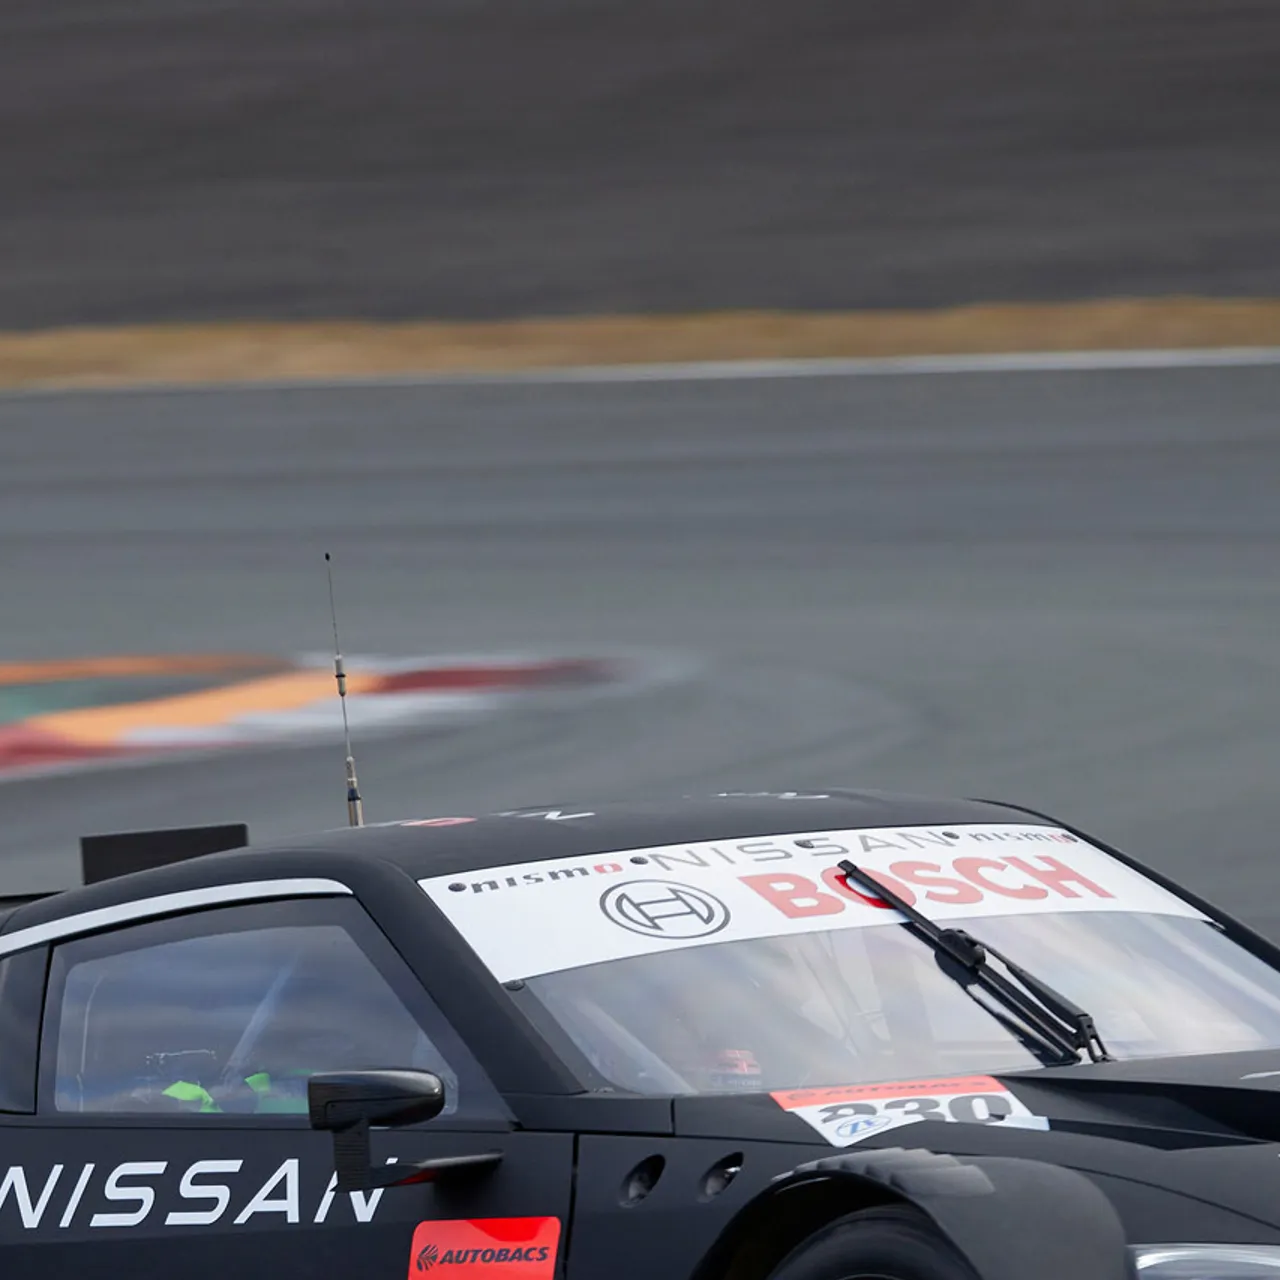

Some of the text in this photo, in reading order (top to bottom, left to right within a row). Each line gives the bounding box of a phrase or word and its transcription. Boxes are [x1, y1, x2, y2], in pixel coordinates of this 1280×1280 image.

[648, 830, 953, 872] NISSAN
[472, 862, 623, 893] nismo
[737, 855, 1118, 919] BOSCH
[440, 1247, 549, 1264] AUTOBACS
